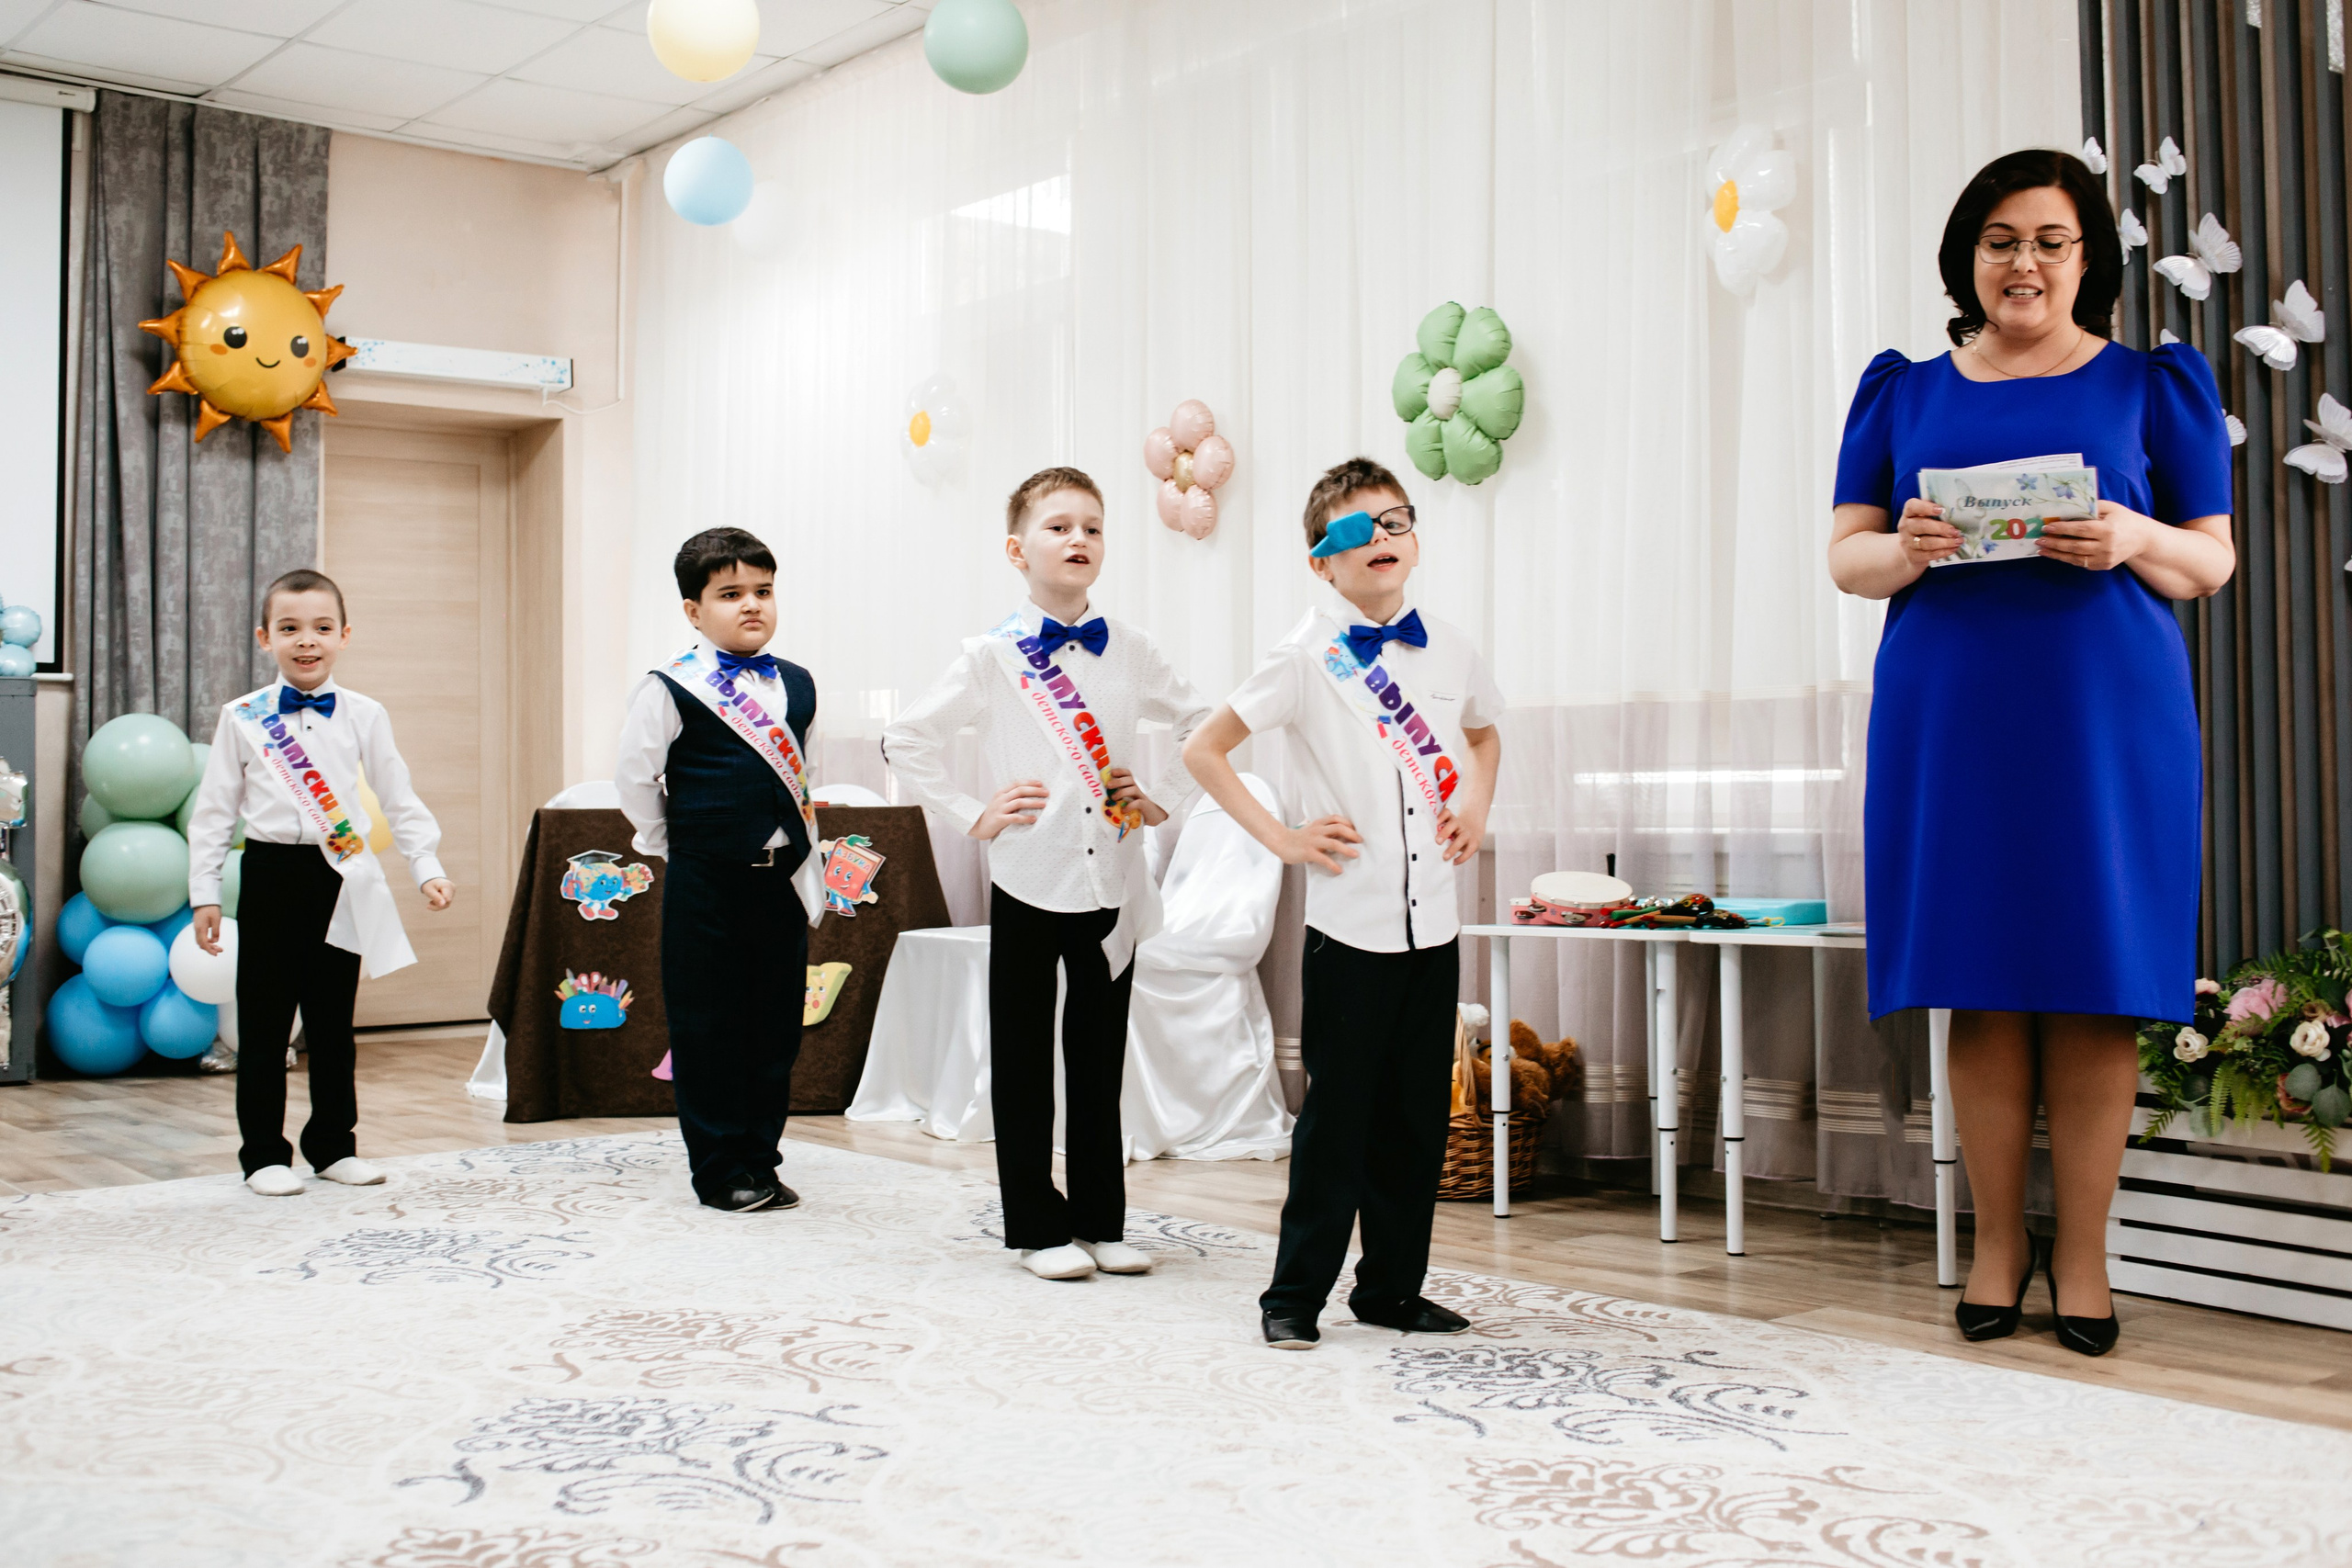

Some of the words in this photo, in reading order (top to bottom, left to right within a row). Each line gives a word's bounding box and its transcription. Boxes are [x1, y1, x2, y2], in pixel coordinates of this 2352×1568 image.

[1963, 495, 2033, 510] Выпуск
[731, 714, 783, 769] детского
[782, 770, 801, 798] сада
[1032, 690, 1082, 761] детского
[1077, 763, 1102, 797] сада
[1364, 664, 1459, 803] ВЫПУСК
[271, 756, 311, 808] детского
[308, 807, 329, 833] сада
